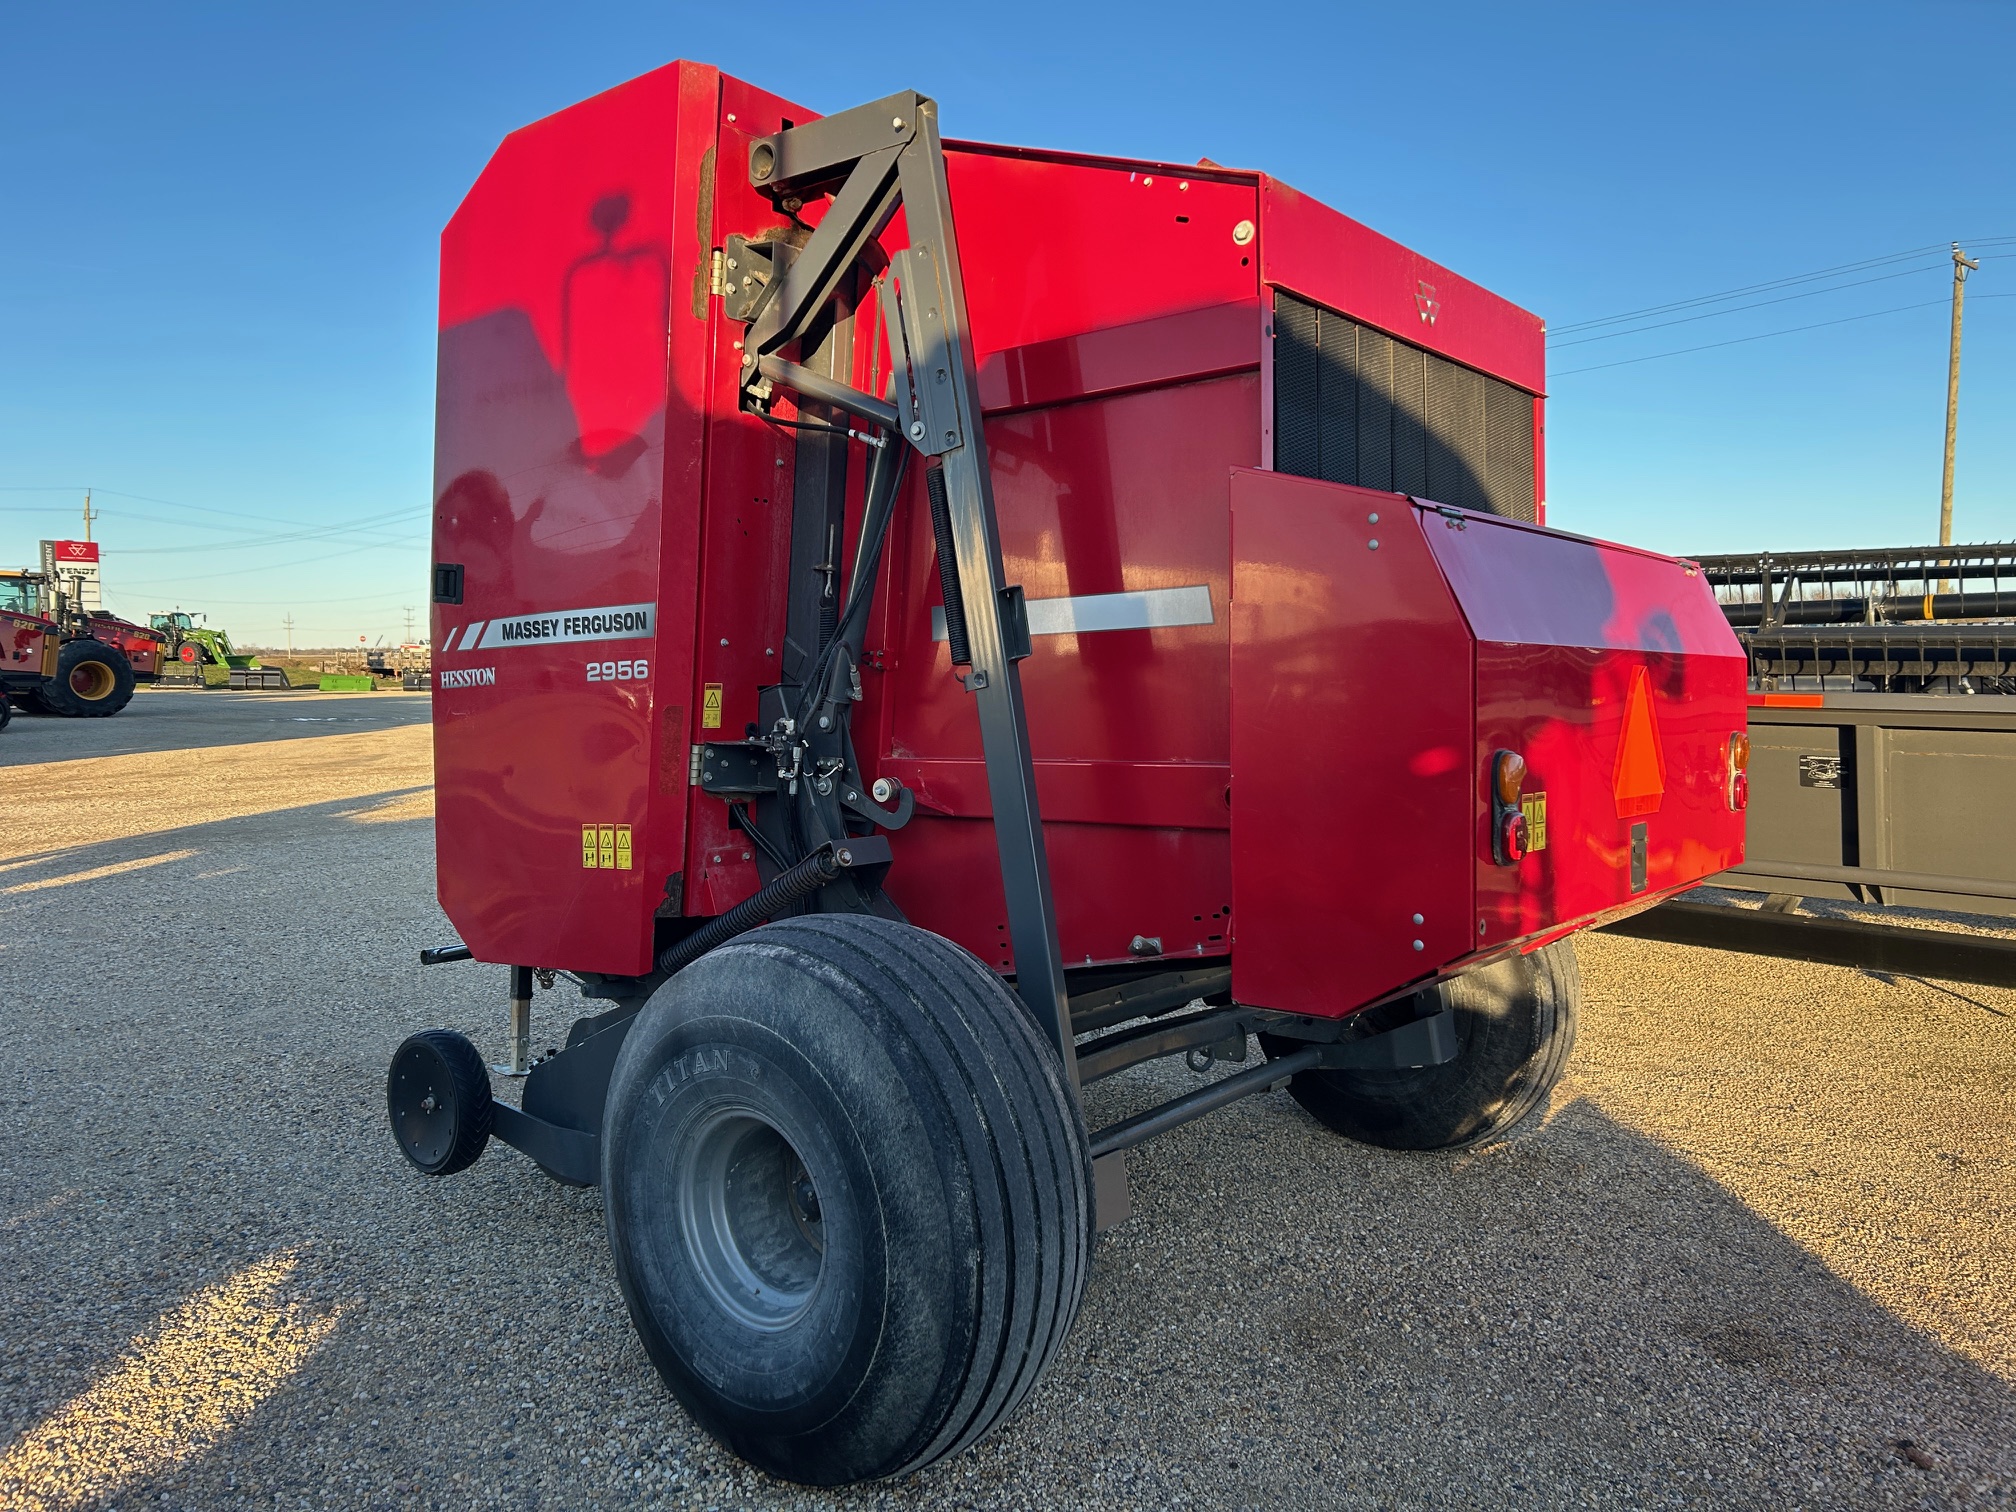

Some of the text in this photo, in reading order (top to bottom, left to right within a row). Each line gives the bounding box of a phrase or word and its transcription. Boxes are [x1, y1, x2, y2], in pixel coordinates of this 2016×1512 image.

[59, 567, 97, 575] FENDT
[13, 619, 36, 631] 620
[133, 631, 151, 640] 620
[502, 611, 647, 641] MASSEY FERGUSON
[440, 667, 496, 689] HESSTON
[586, 660, 649, 682] 2956
[649, 1049, 731, 1107] TITAN
